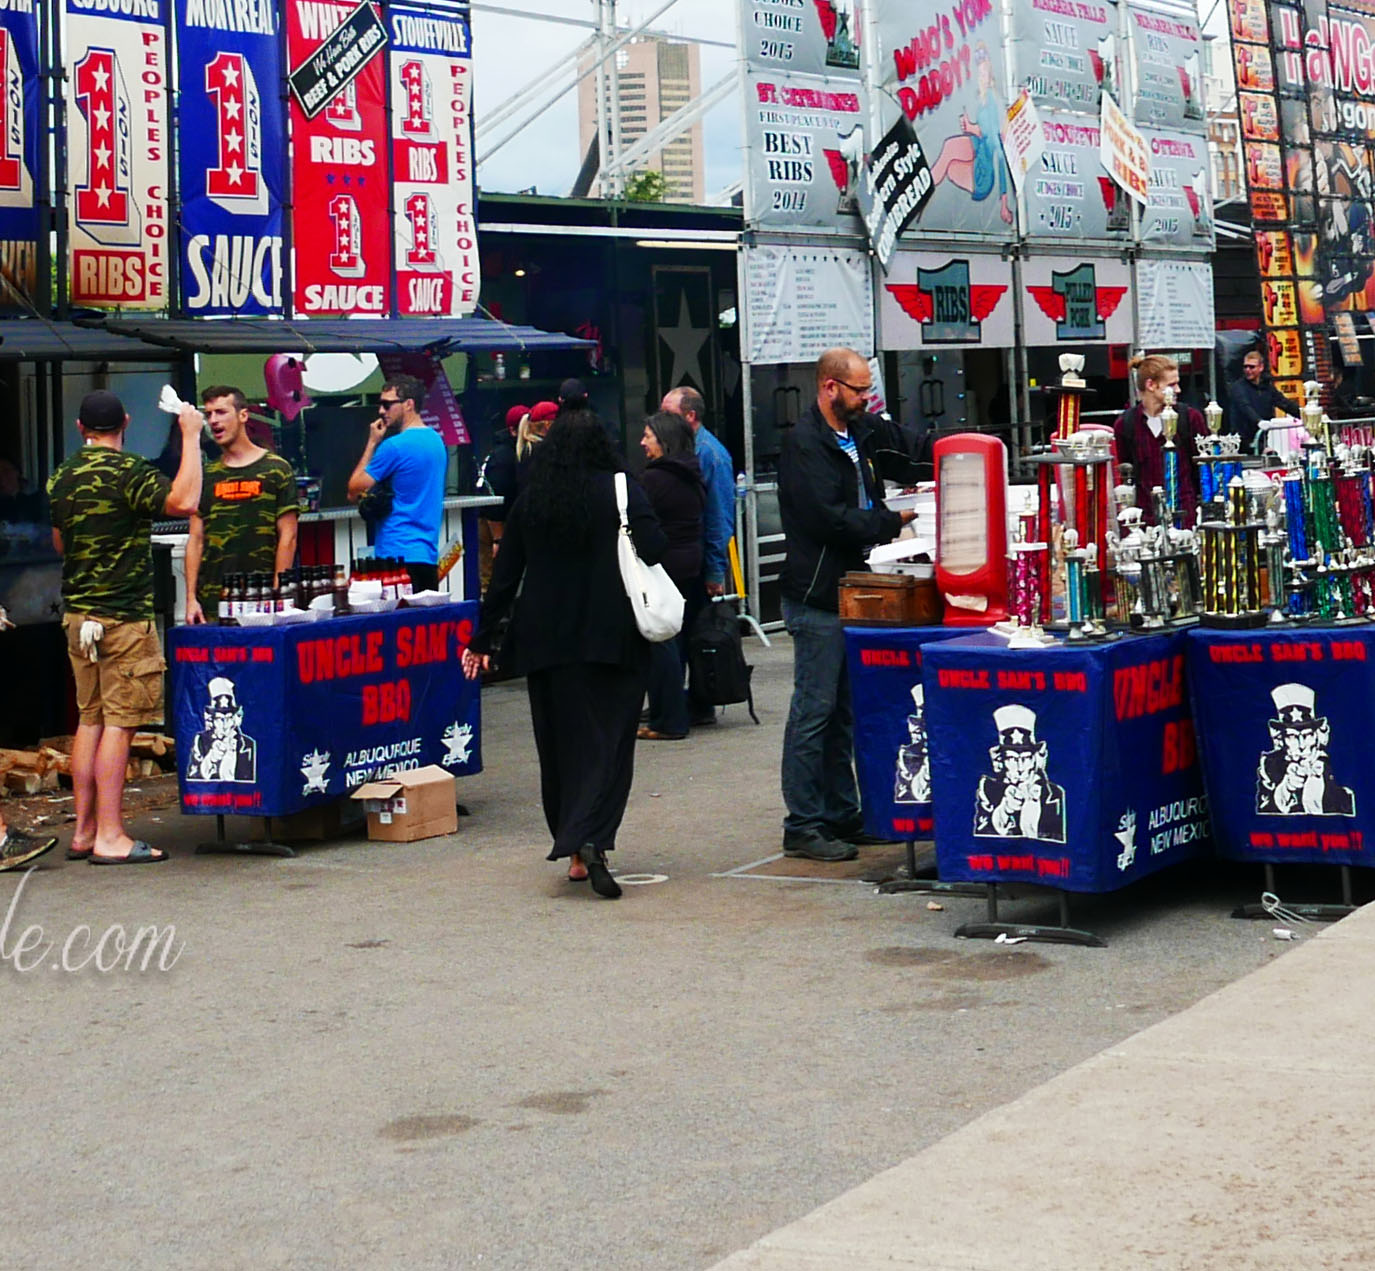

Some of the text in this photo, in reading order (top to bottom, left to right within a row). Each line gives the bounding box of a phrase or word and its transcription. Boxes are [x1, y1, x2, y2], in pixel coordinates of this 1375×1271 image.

[392, 13, 469, 54] STOUFFVILLE
[753, 11, 803, 33] CHOICE
[1044, 22, 1079, 49] SAUCE
[760, 39, 794, 61] 2015
[893, 13, 956, 83] WHO'S
[895, 43, 972, 122] DADDY?
[310, 135, 376, 167] RIBS
[763, 131, 812, 156] BEST
[408, 146, 438, 182] RIBS
[767, 159, 814, 183] RIBS
[1041, 151, 1078, 176] SAUCE
[773, 190, 807, 211] 2014
[1048, 204, 1073, 230] 2015
[1154, 217, 1179, 234] 2015
[79, 255, 144, 296] RIBS
[187, 234, 284, 309] SAUCE
[304, 284, 384, 311] SAUCE
[408, 278, 444, 313] SAUCE
[934, 285, 969, 324] RIBS
[296, 631, 384, 684] UNCLE
[861, 649, 910, 667] UNCLE
[1208, 641, 1367, 663] UNCLE SAM'S BBQ
[938, 669, 1087, 693] UNCLE SAM'S BBQ
[1112, 654, 1184, 722] UNCLE
[361, 679, 412, 726] BBQ
[345, 768, 372, 789] NEW
[1150, 829, 1172, 858] NEW
